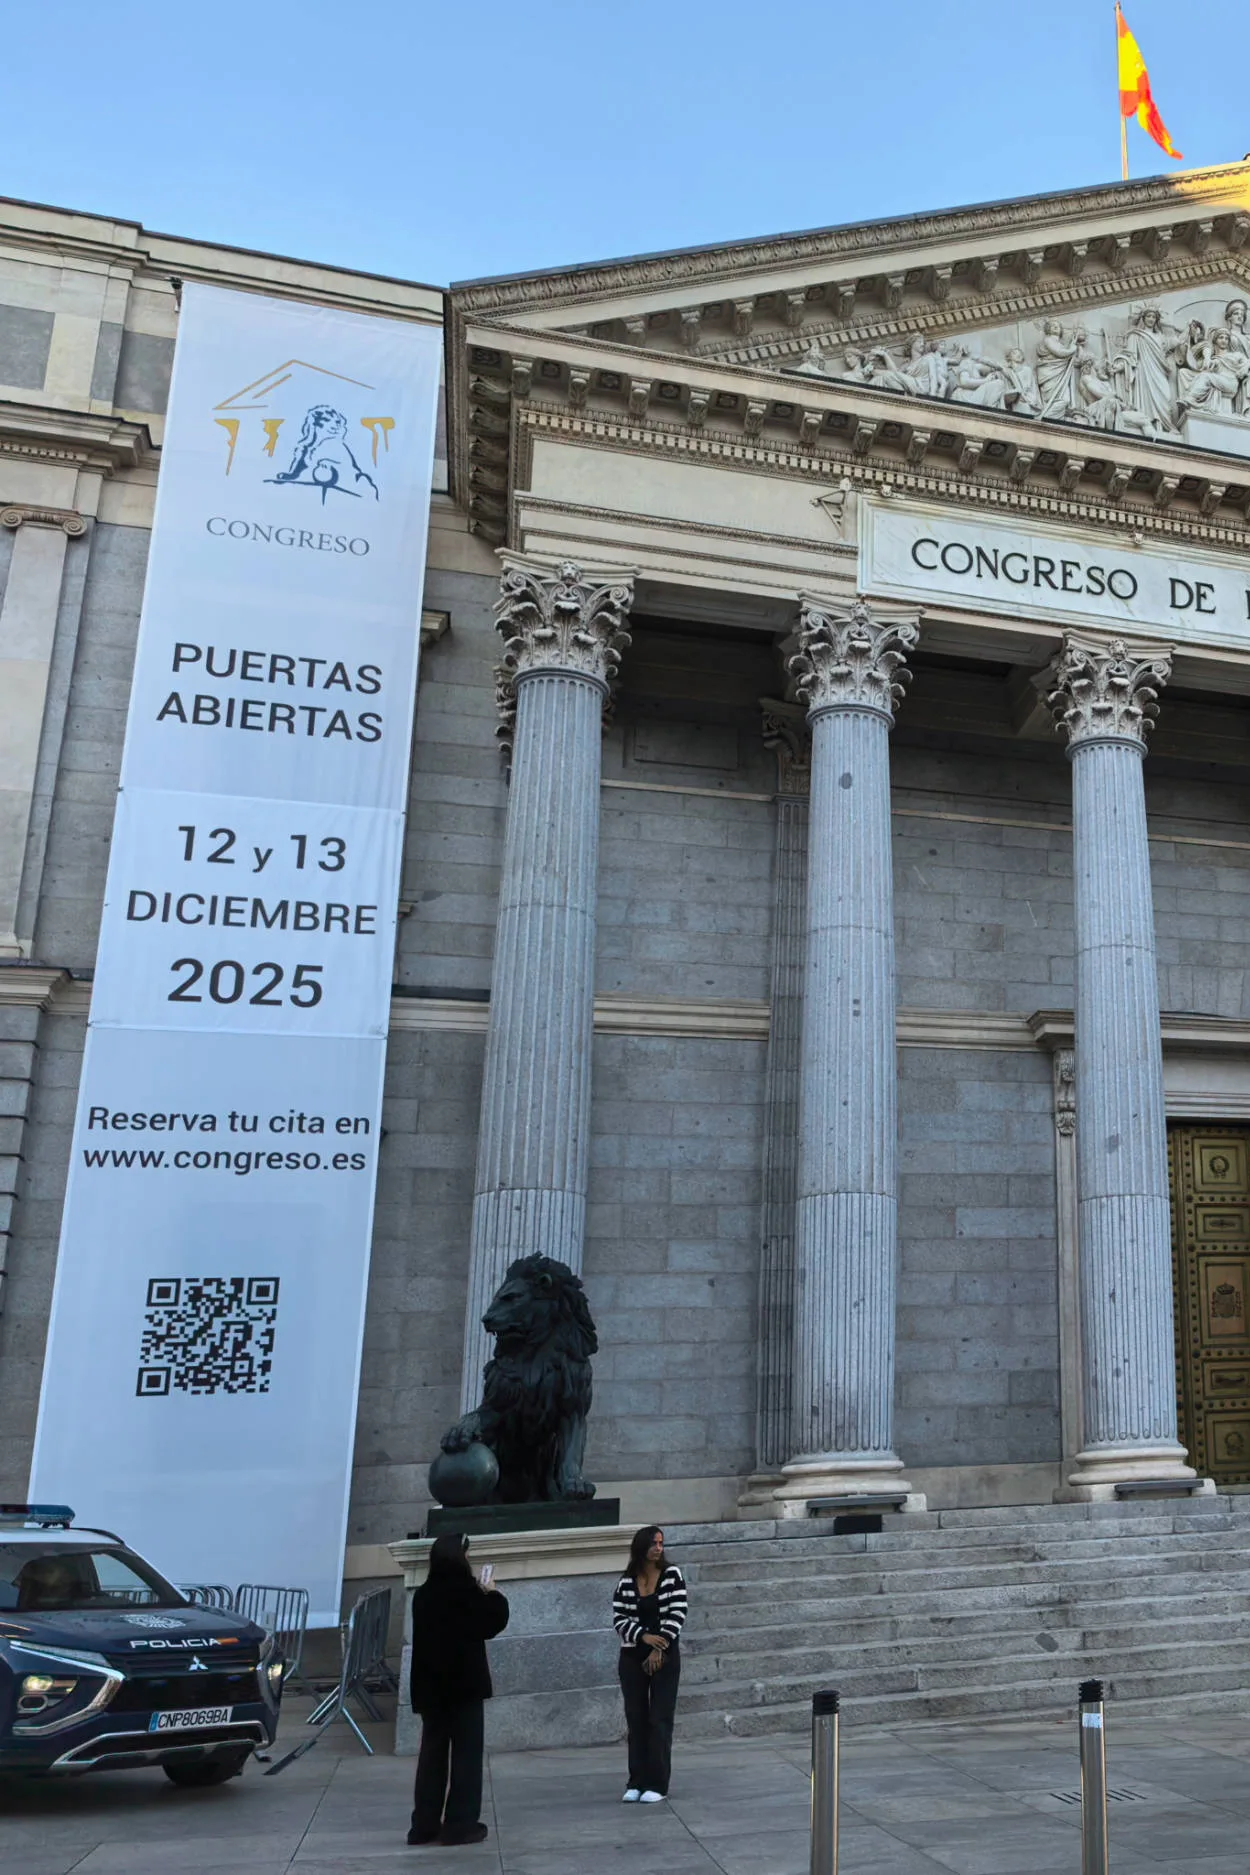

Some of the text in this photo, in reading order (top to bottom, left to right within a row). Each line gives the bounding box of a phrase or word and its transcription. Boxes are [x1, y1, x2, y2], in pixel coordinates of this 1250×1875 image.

[206, 516, 370, 557] CONGRESO
[911, 537, 1139, 600] CONGRESO
[1169, 578, 1217, 615] DE
[171, 642, 383, 695] PUERTAS
[155, 691, 384, 743] ABIERTAS
[177, 825, 348, 874] 12 y 13
[126, 889, 379, 936] DICIEMBRE
[167, 957, 324, 1008] 2025
[87, 1106, 371, 1135] Reserva tu cita en
[83, 1148, 367, 1176] www.congreso.es
[129, 1638, 222, 1649] POLICIA
